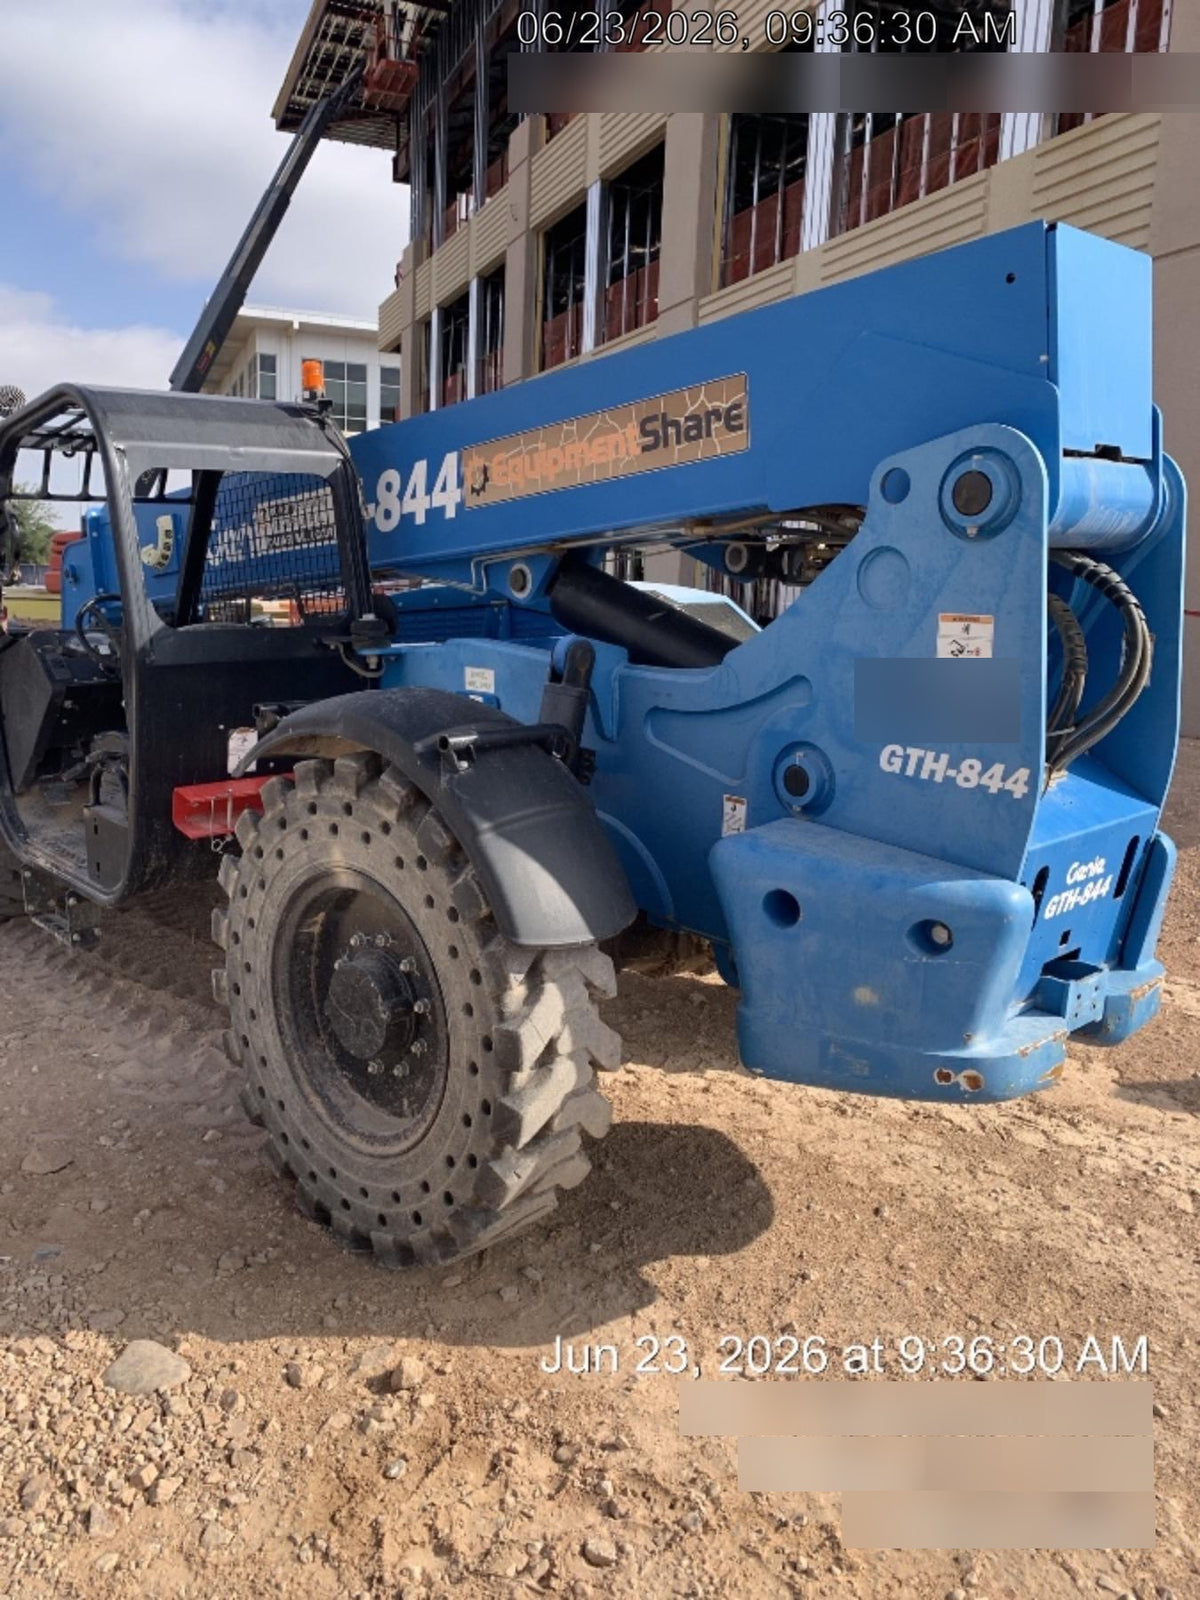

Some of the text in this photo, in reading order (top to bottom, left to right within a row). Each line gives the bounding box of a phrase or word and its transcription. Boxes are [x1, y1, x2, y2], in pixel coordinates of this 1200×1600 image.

[491, 401, 744, 488] EquipmentShare
[879, 744, 1030, 799] GTH-844
[1044, 874, 1114, 920] GTH-844
